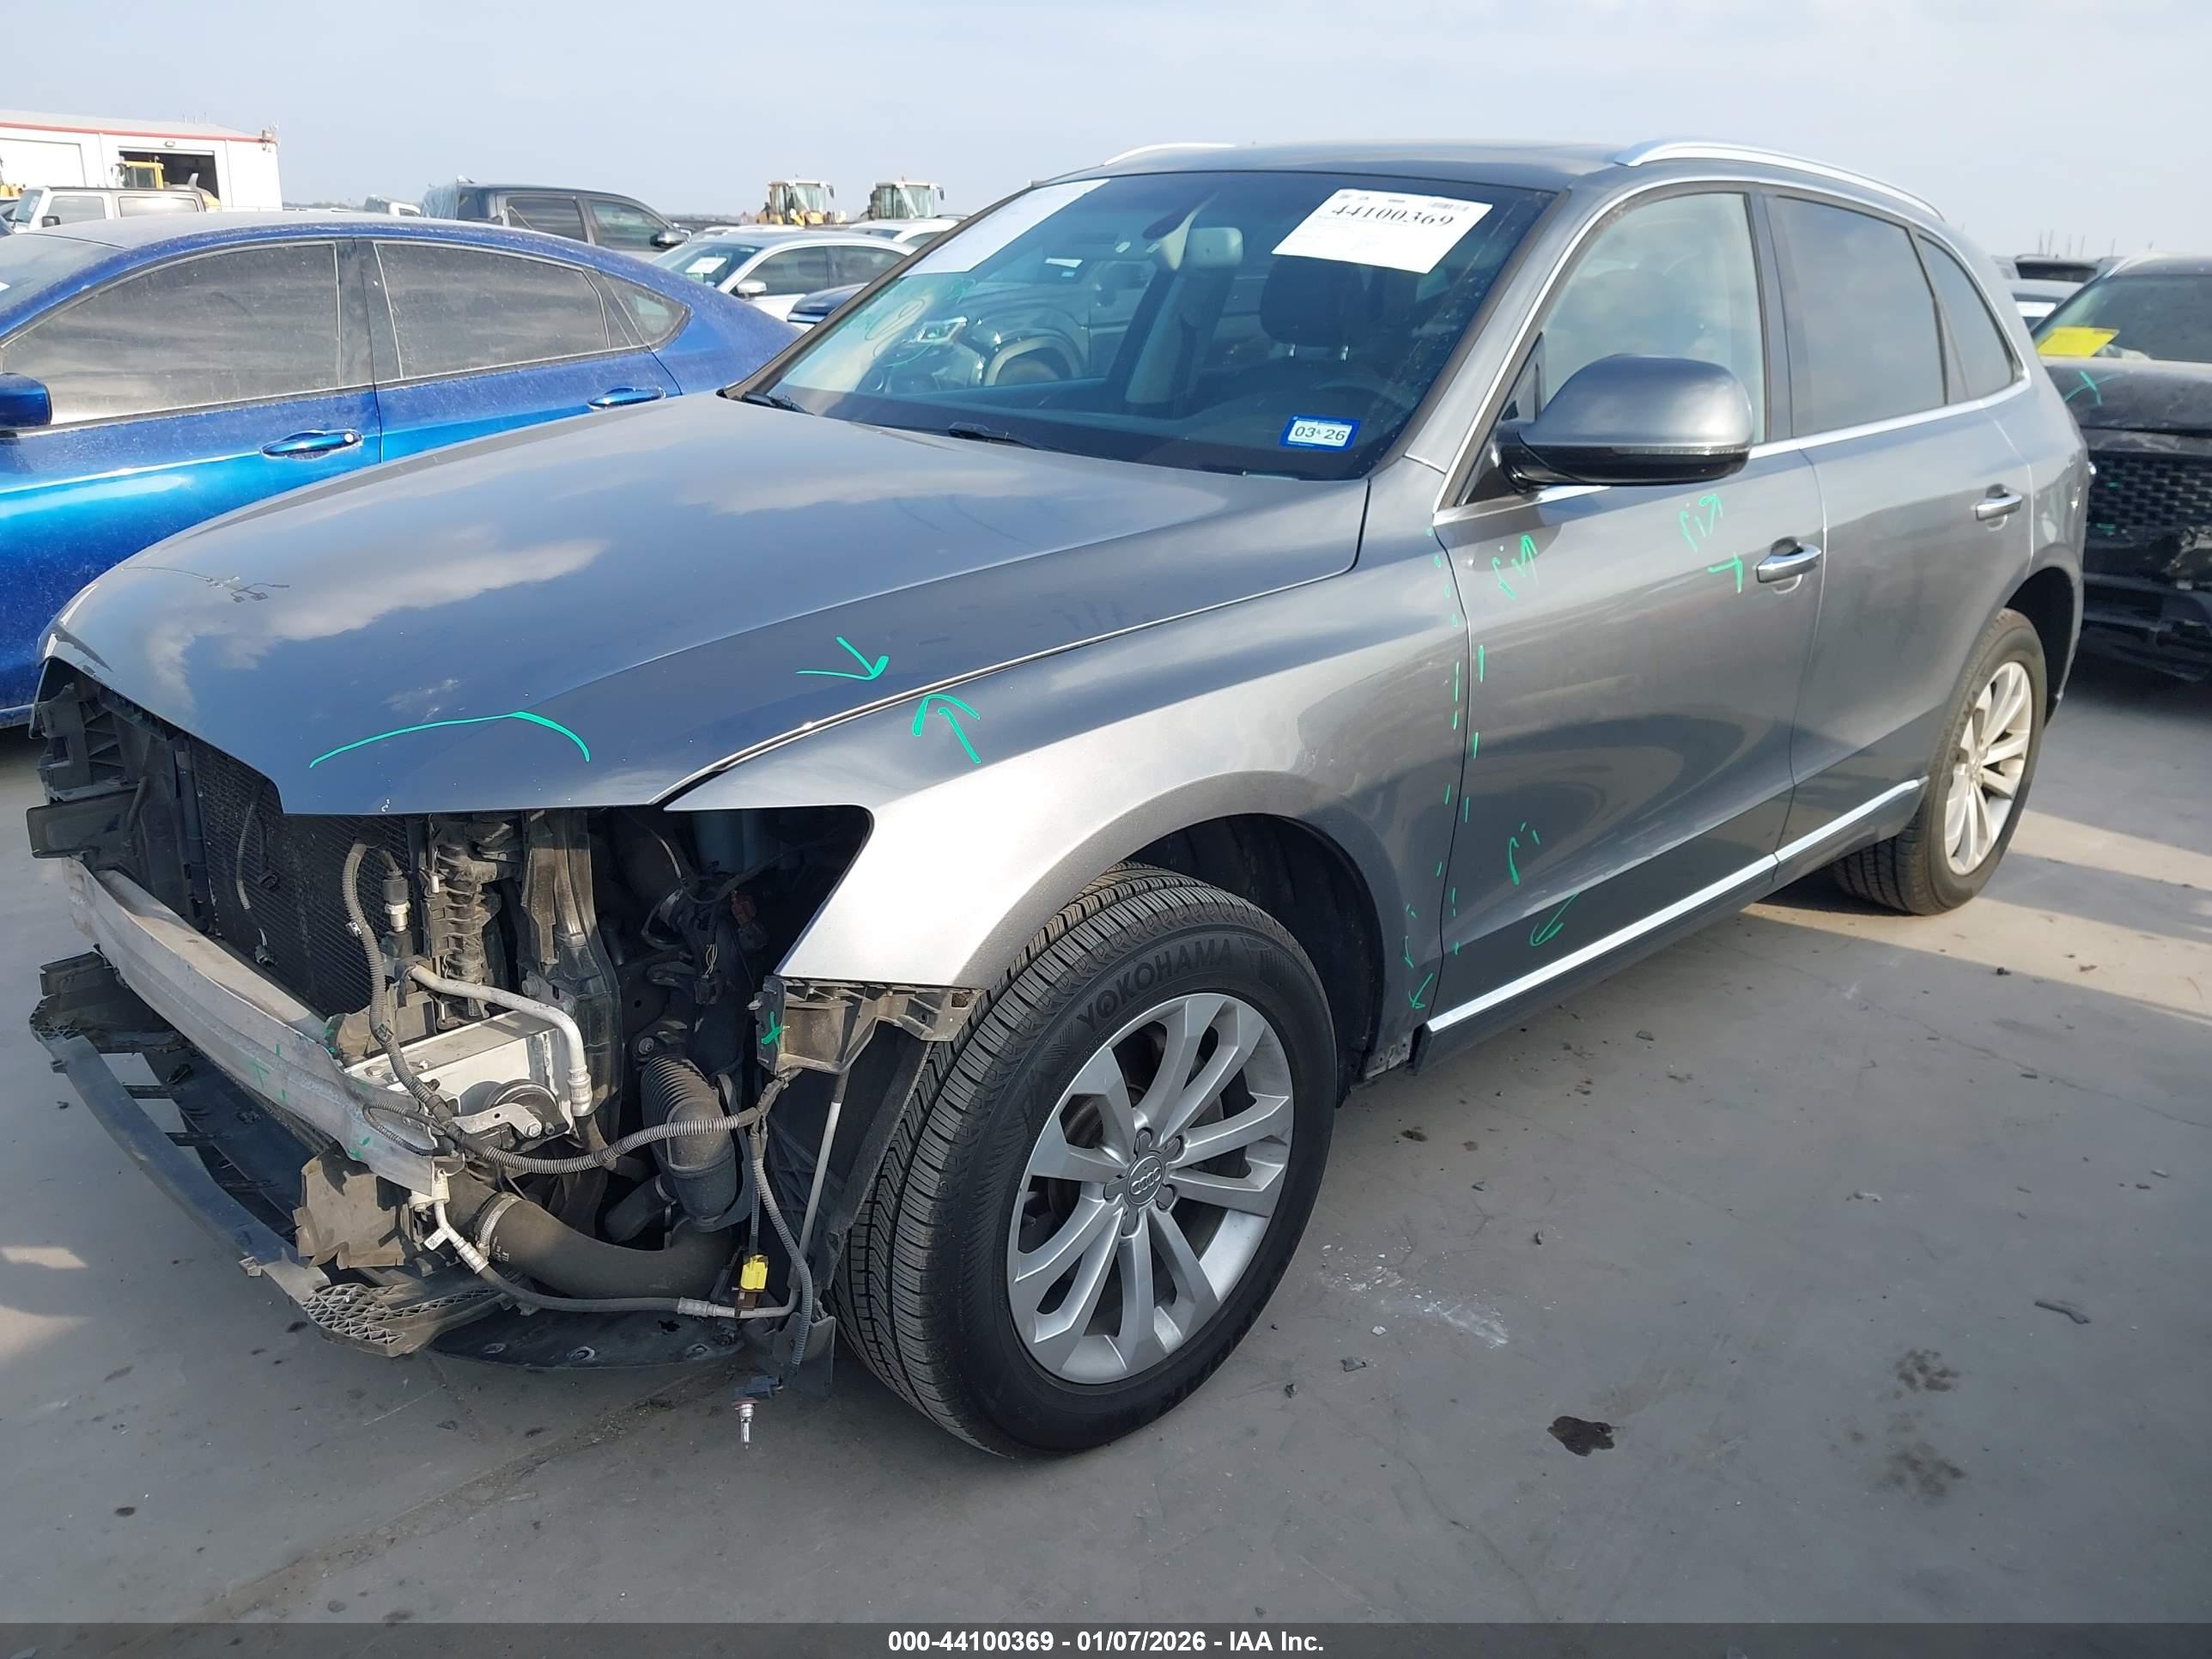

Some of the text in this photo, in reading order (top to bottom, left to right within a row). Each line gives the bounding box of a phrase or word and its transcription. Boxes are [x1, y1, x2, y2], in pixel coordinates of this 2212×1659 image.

[1332, 204, 1455, 226] 44100369
[1295, 426, 1346, 441] 03 26
[1076, 938, 1232, 1030] YOKOHAMA
